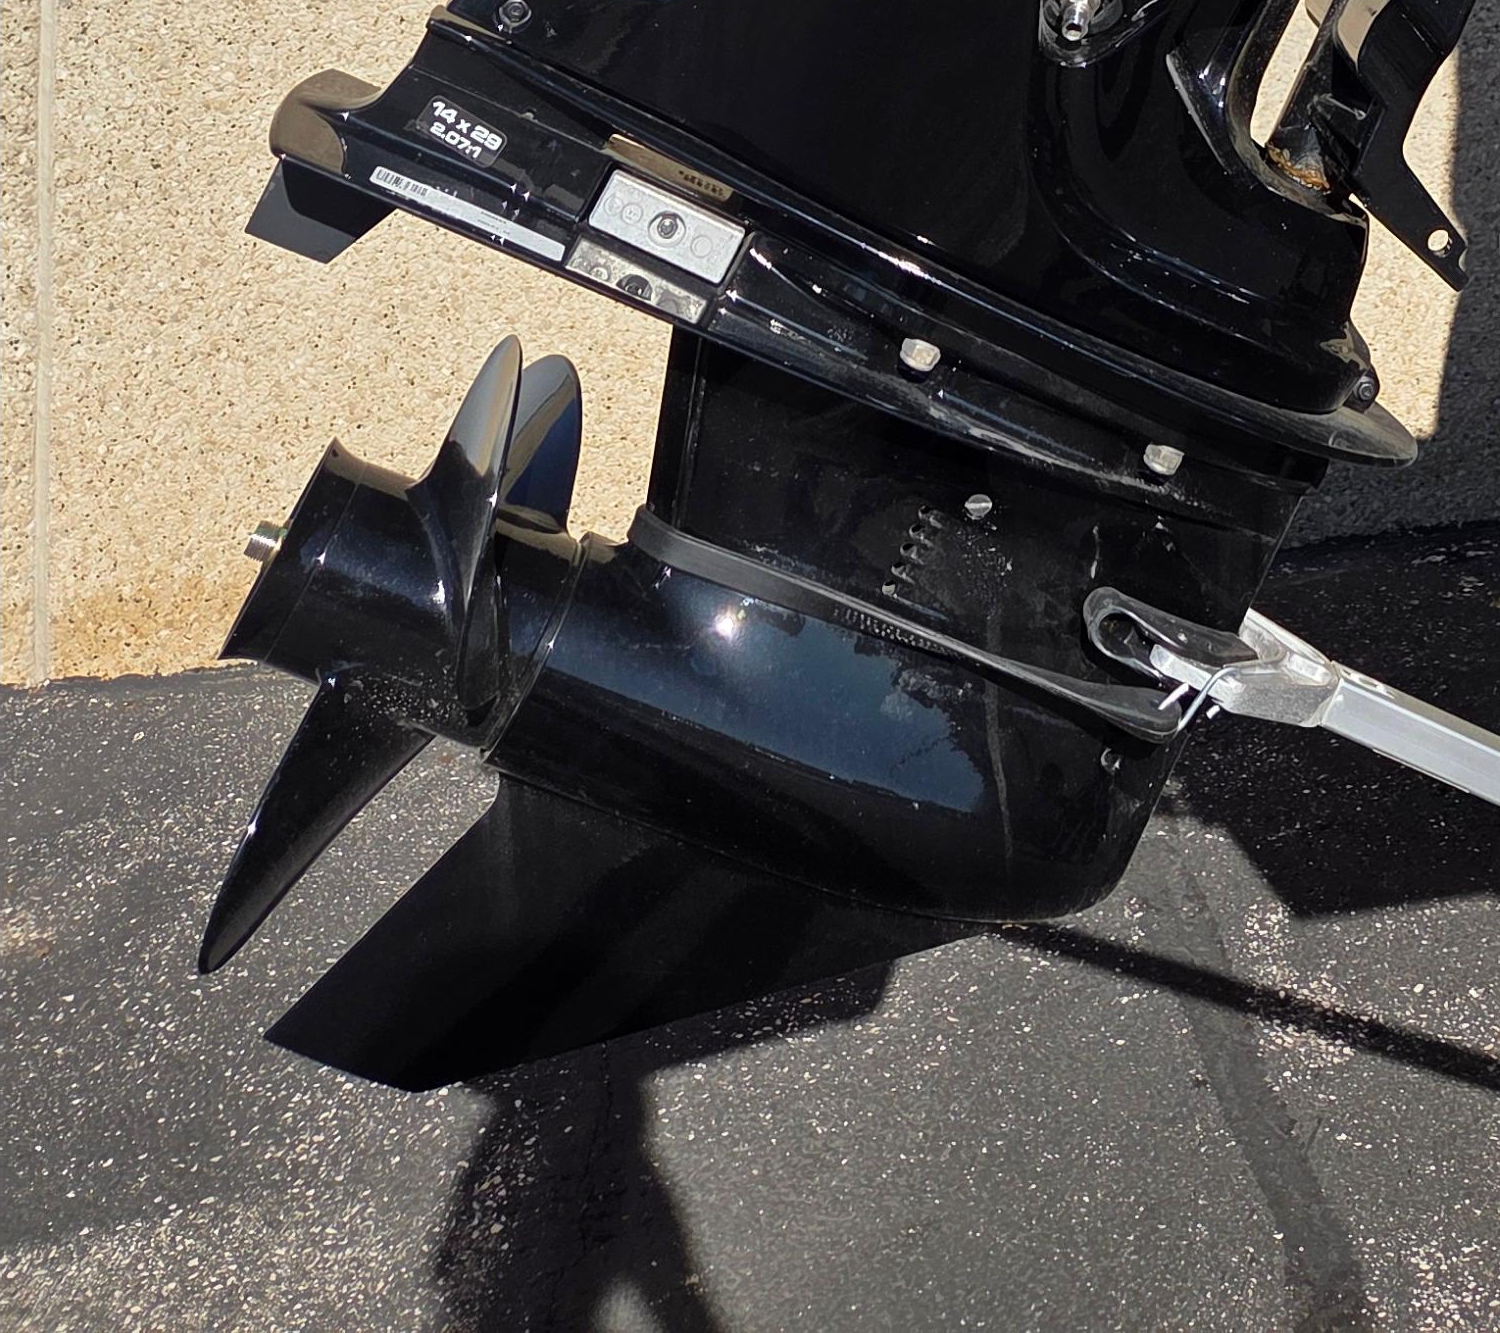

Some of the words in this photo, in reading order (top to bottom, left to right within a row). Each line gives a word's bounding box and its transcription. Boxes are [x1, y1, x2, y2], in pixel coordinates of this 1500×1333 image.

[430, 121, 482, 159] 2.07:1
[432, 101, 458, 124] 14
[456, 119, 470, 133] x
[470, 124, 503, 151] 29
